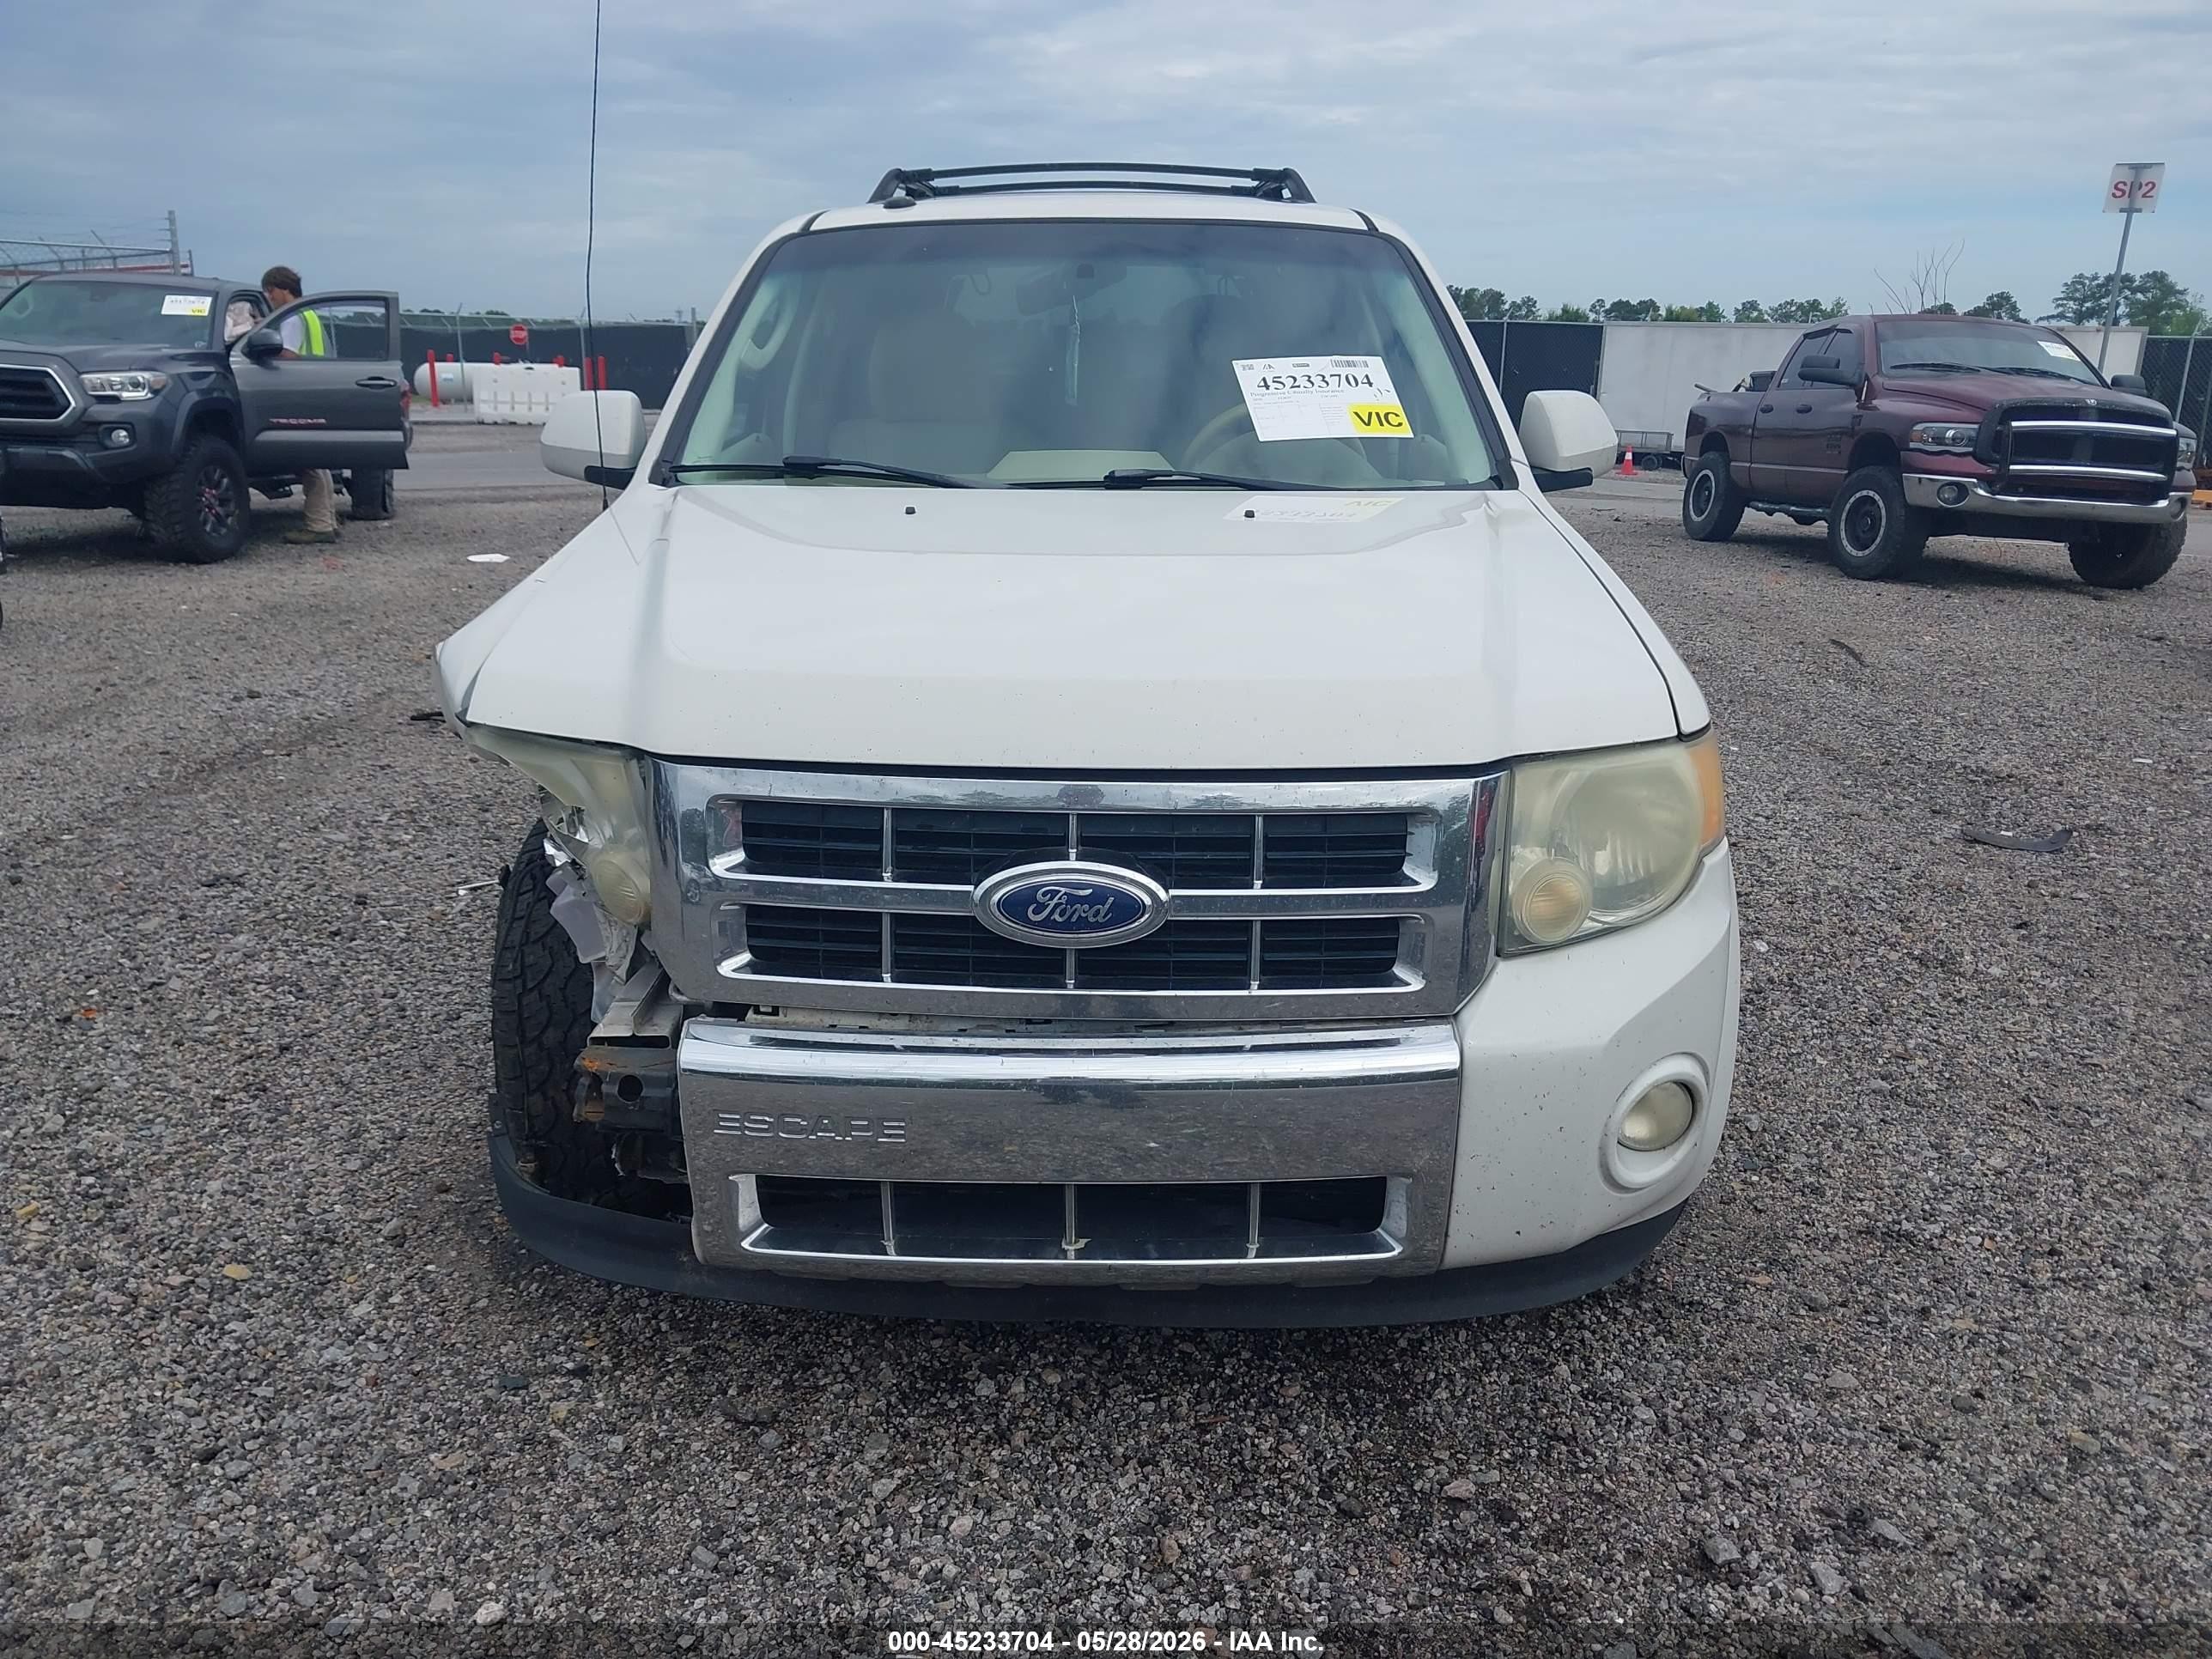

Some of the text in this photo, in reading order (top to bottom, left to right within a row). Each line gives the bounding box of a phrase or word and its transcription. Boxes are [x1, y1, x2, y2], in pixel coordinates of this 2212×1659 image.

[2112, 180, 2157, 198] SP2
[1256, 373, 1374, 391] 45233704
[1352, 410, 1403, 428] VIC
[1027, 885, 1115, 923] Ford
[713, 1109, 907, 1143] ESCAPE
